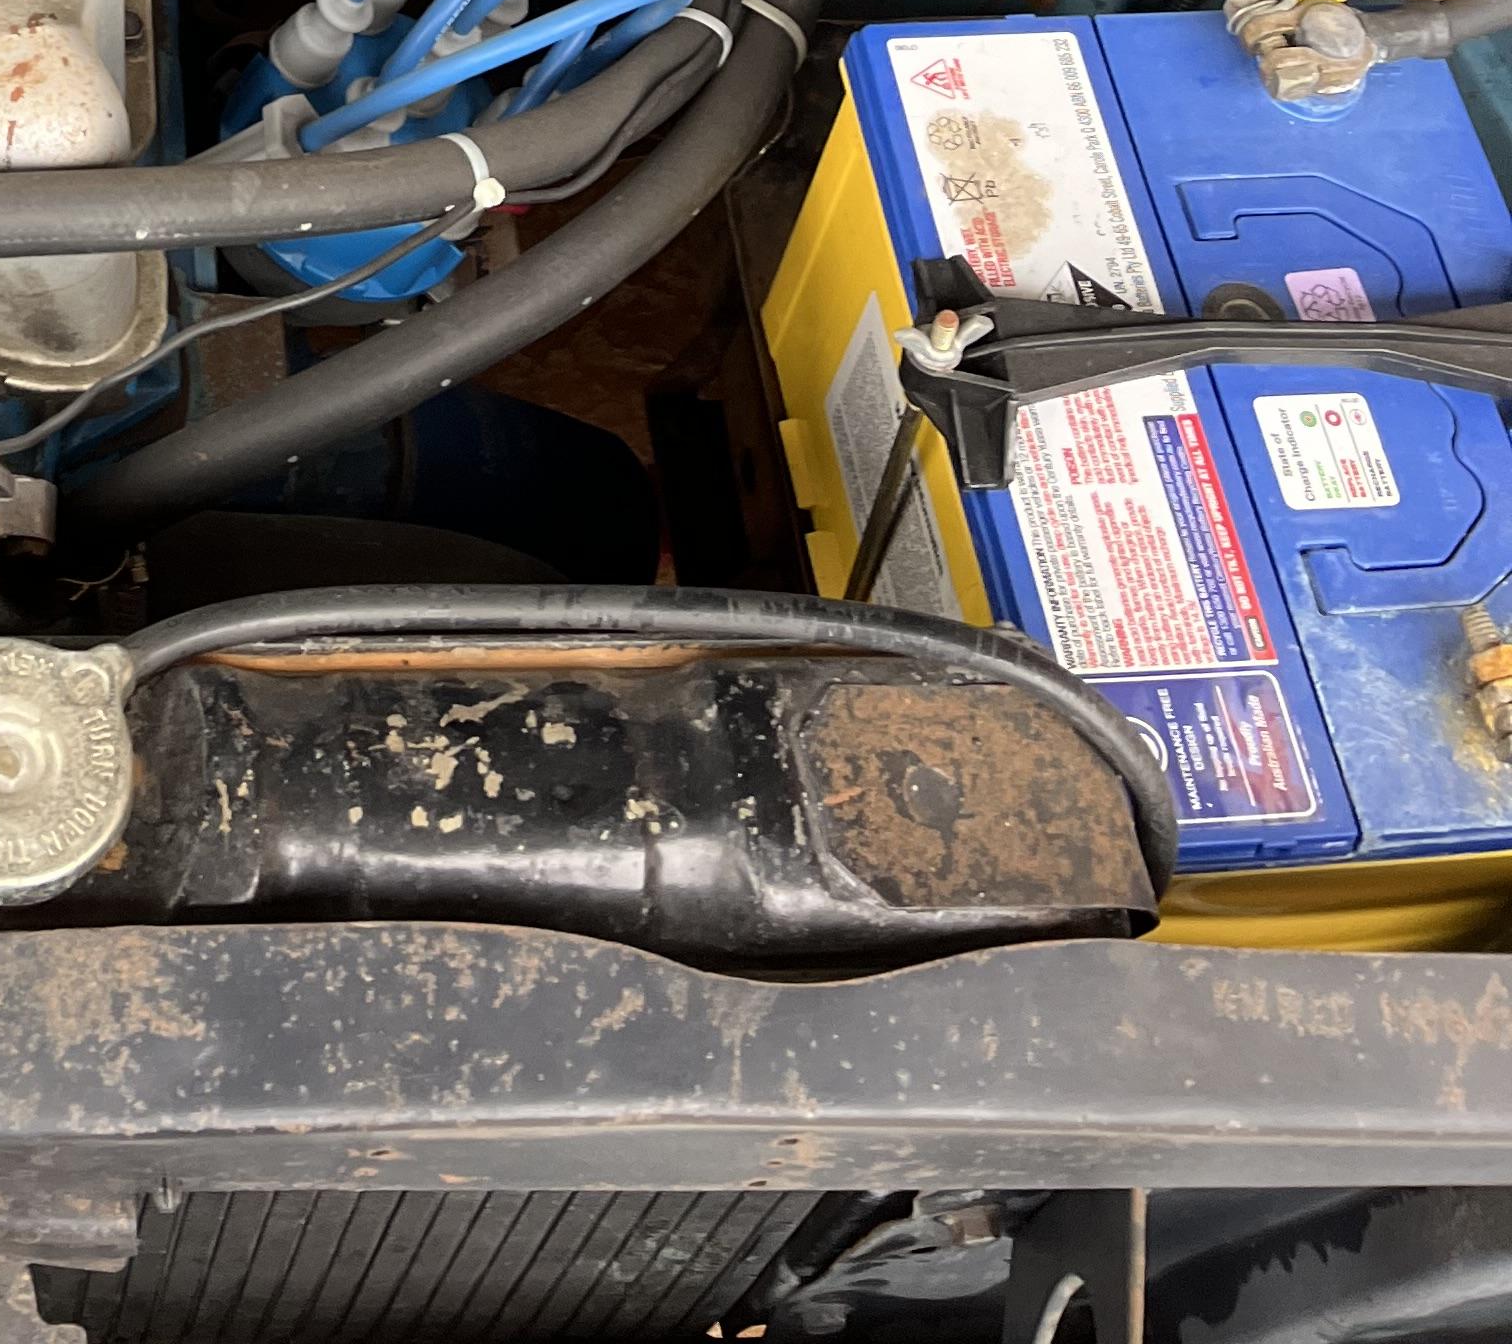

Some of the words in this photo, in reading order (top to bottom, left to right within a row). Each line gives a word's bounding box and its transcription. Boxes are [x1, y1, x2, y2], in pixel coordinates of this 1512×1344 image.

[1061, 67, 1079, 80] 009
[1104, 257, 1122, 277] 2794
[1118, 247, 1137, 259] Ltd
[1123, 260, 1145, 273] Pty
[983, 260, 1002, 287] FILLED
[1270, 432, 1283, 444] of
[1275, 407, 1301, 457] Indicator
[1274, 447, 1293, 476] State
[1374, 457, 1393, 496] BATTERY
[1293, 460, 1317, 501] Charge
[1156, 687, 1176, 720] FREE
[1247, 694, 1269, 728] Made
[82, 703, 116, 779] TURN
[1182, 724, 1205, 771] DESIGN
[1167, 722, 1202, 810] MAINTENANCE
[1259, 730, 1287, 792] Australian
